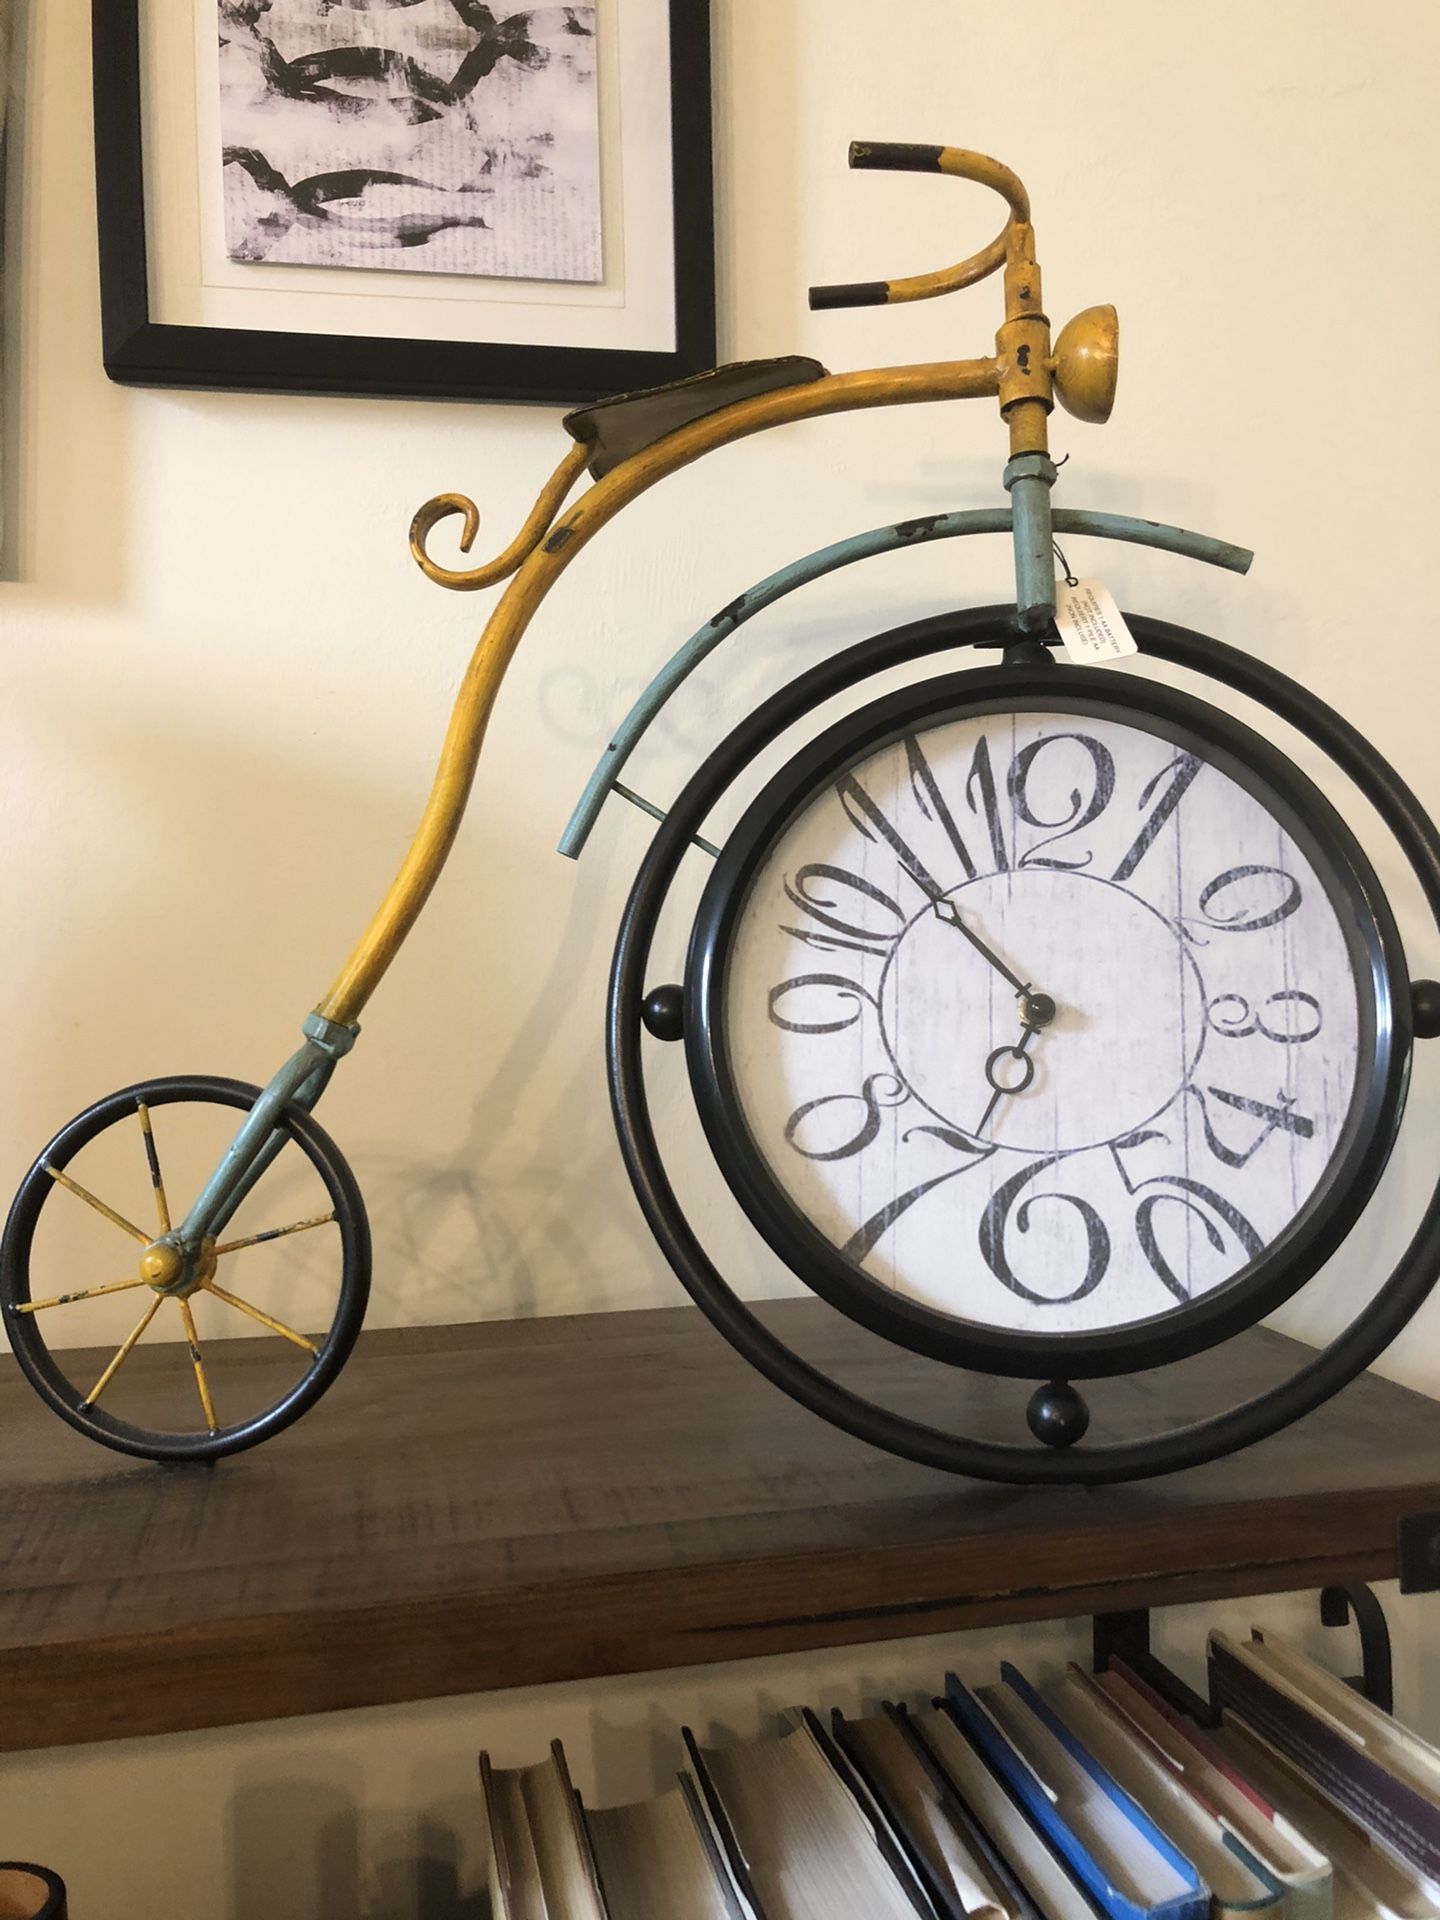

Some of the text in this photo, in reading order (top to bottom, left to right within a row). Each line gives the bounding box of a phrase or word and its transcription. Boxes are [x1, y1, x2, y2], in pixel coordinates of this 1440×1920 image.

[1065, 605, 1076, 618] (NON
[1081, 600, 1106, 644] (NOT INCLUDED)
[1087, 629, 1096, 641] PILE
[1105, 628, 1120, 653] BATTERY
[835, 735, 977, 898] 11
[966, 733, 1115, 872] 12
[1111, 753, 1204, 881] 1
[779, 863, 907, 957] 10
[1174, 865, 1302, 945] 2
[768, 974, 881, 1035] 9
[1207, 991, 1322, 1044] 3
[784, 1073, 912, 1161] 8
[1184, 1083, 1314, 1168] 4
[842, 1125, 999, 1265] 7
[978, 1152, 1111, 1306] 6
[1108, 1130, 1265, 1300] 5
